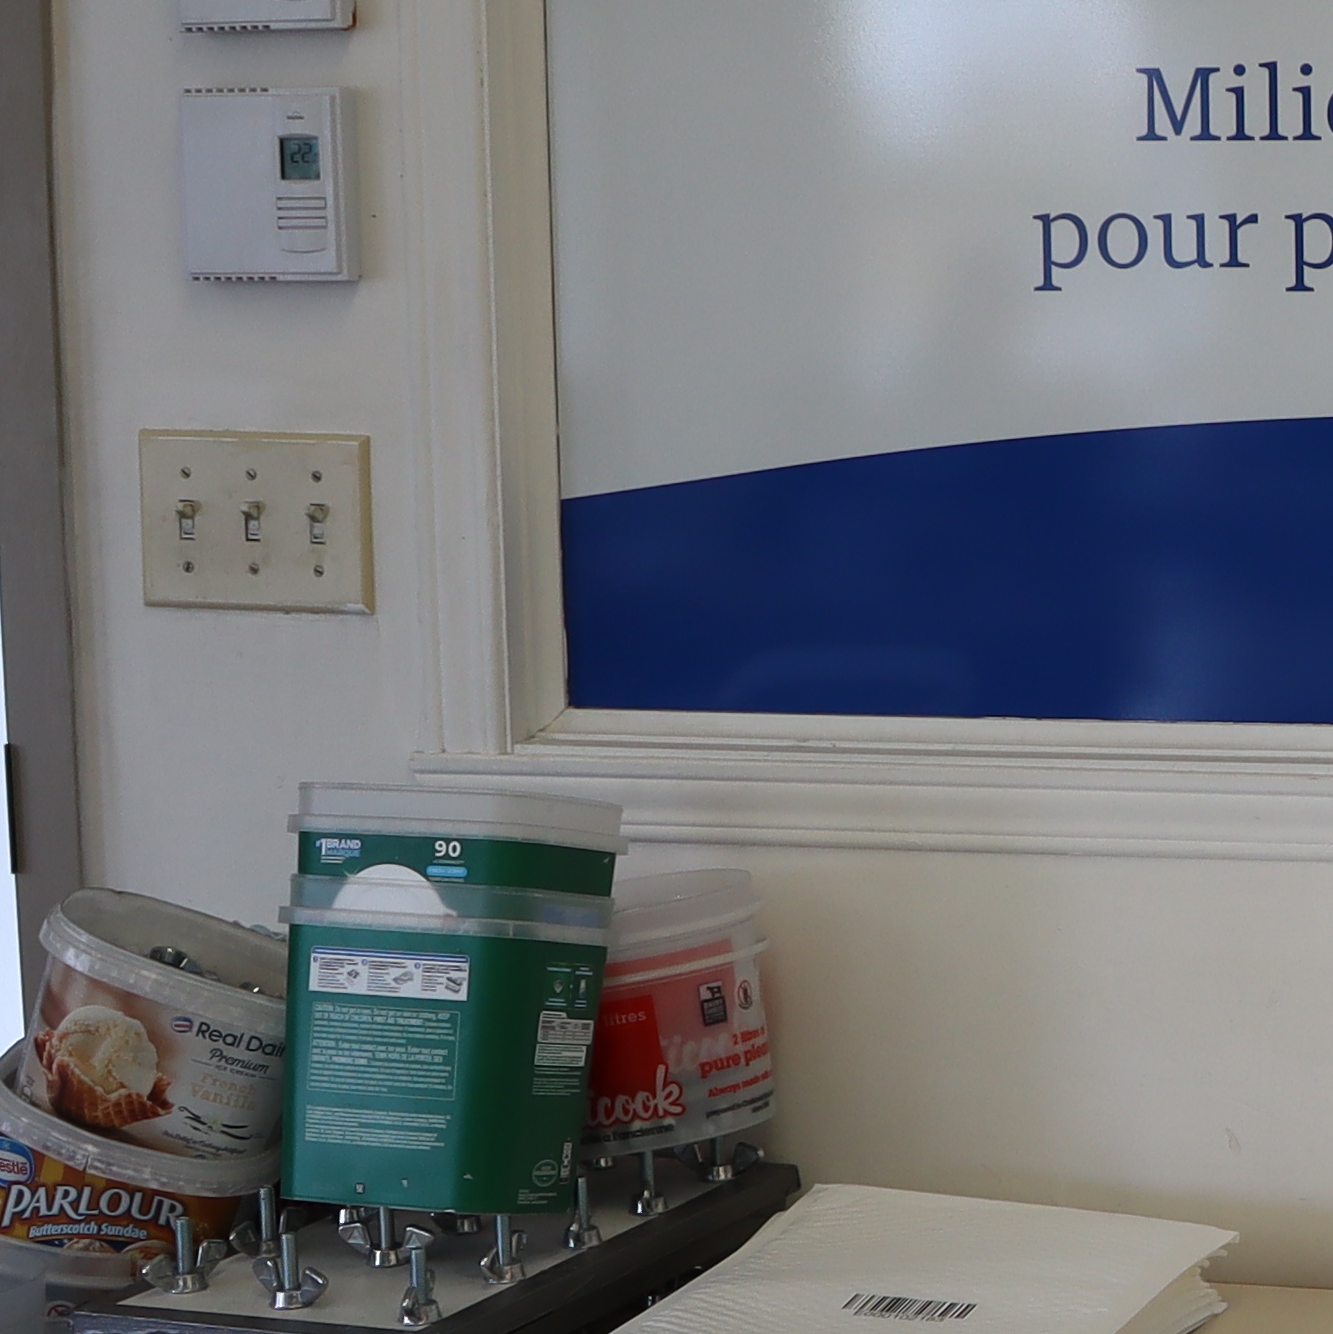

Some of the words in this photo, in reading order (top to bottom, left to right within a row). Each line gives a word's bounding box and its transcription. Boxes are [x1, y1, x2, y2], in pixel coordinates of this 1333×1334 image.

[1033, 213, 1259, 293] pour
[326, 838, 361, 849] BRAND
[434, 840, 462, 858] 90
[195, 1021, 245, 1049] Real
[209, 1048, 271, 1074] Premium
[699, 1053, 741, 1079] pure
[191, 1082, 256, 1111] Vanilla
[201, 1072, 257, 1095] French
[0, 1157, 28, 1176] estlé
[1, 1183, 184, 1230] PARLOUR
[29, 1221, 98, 1238] Butterscotch
[100, 1222, 148, 1240] Sundae
